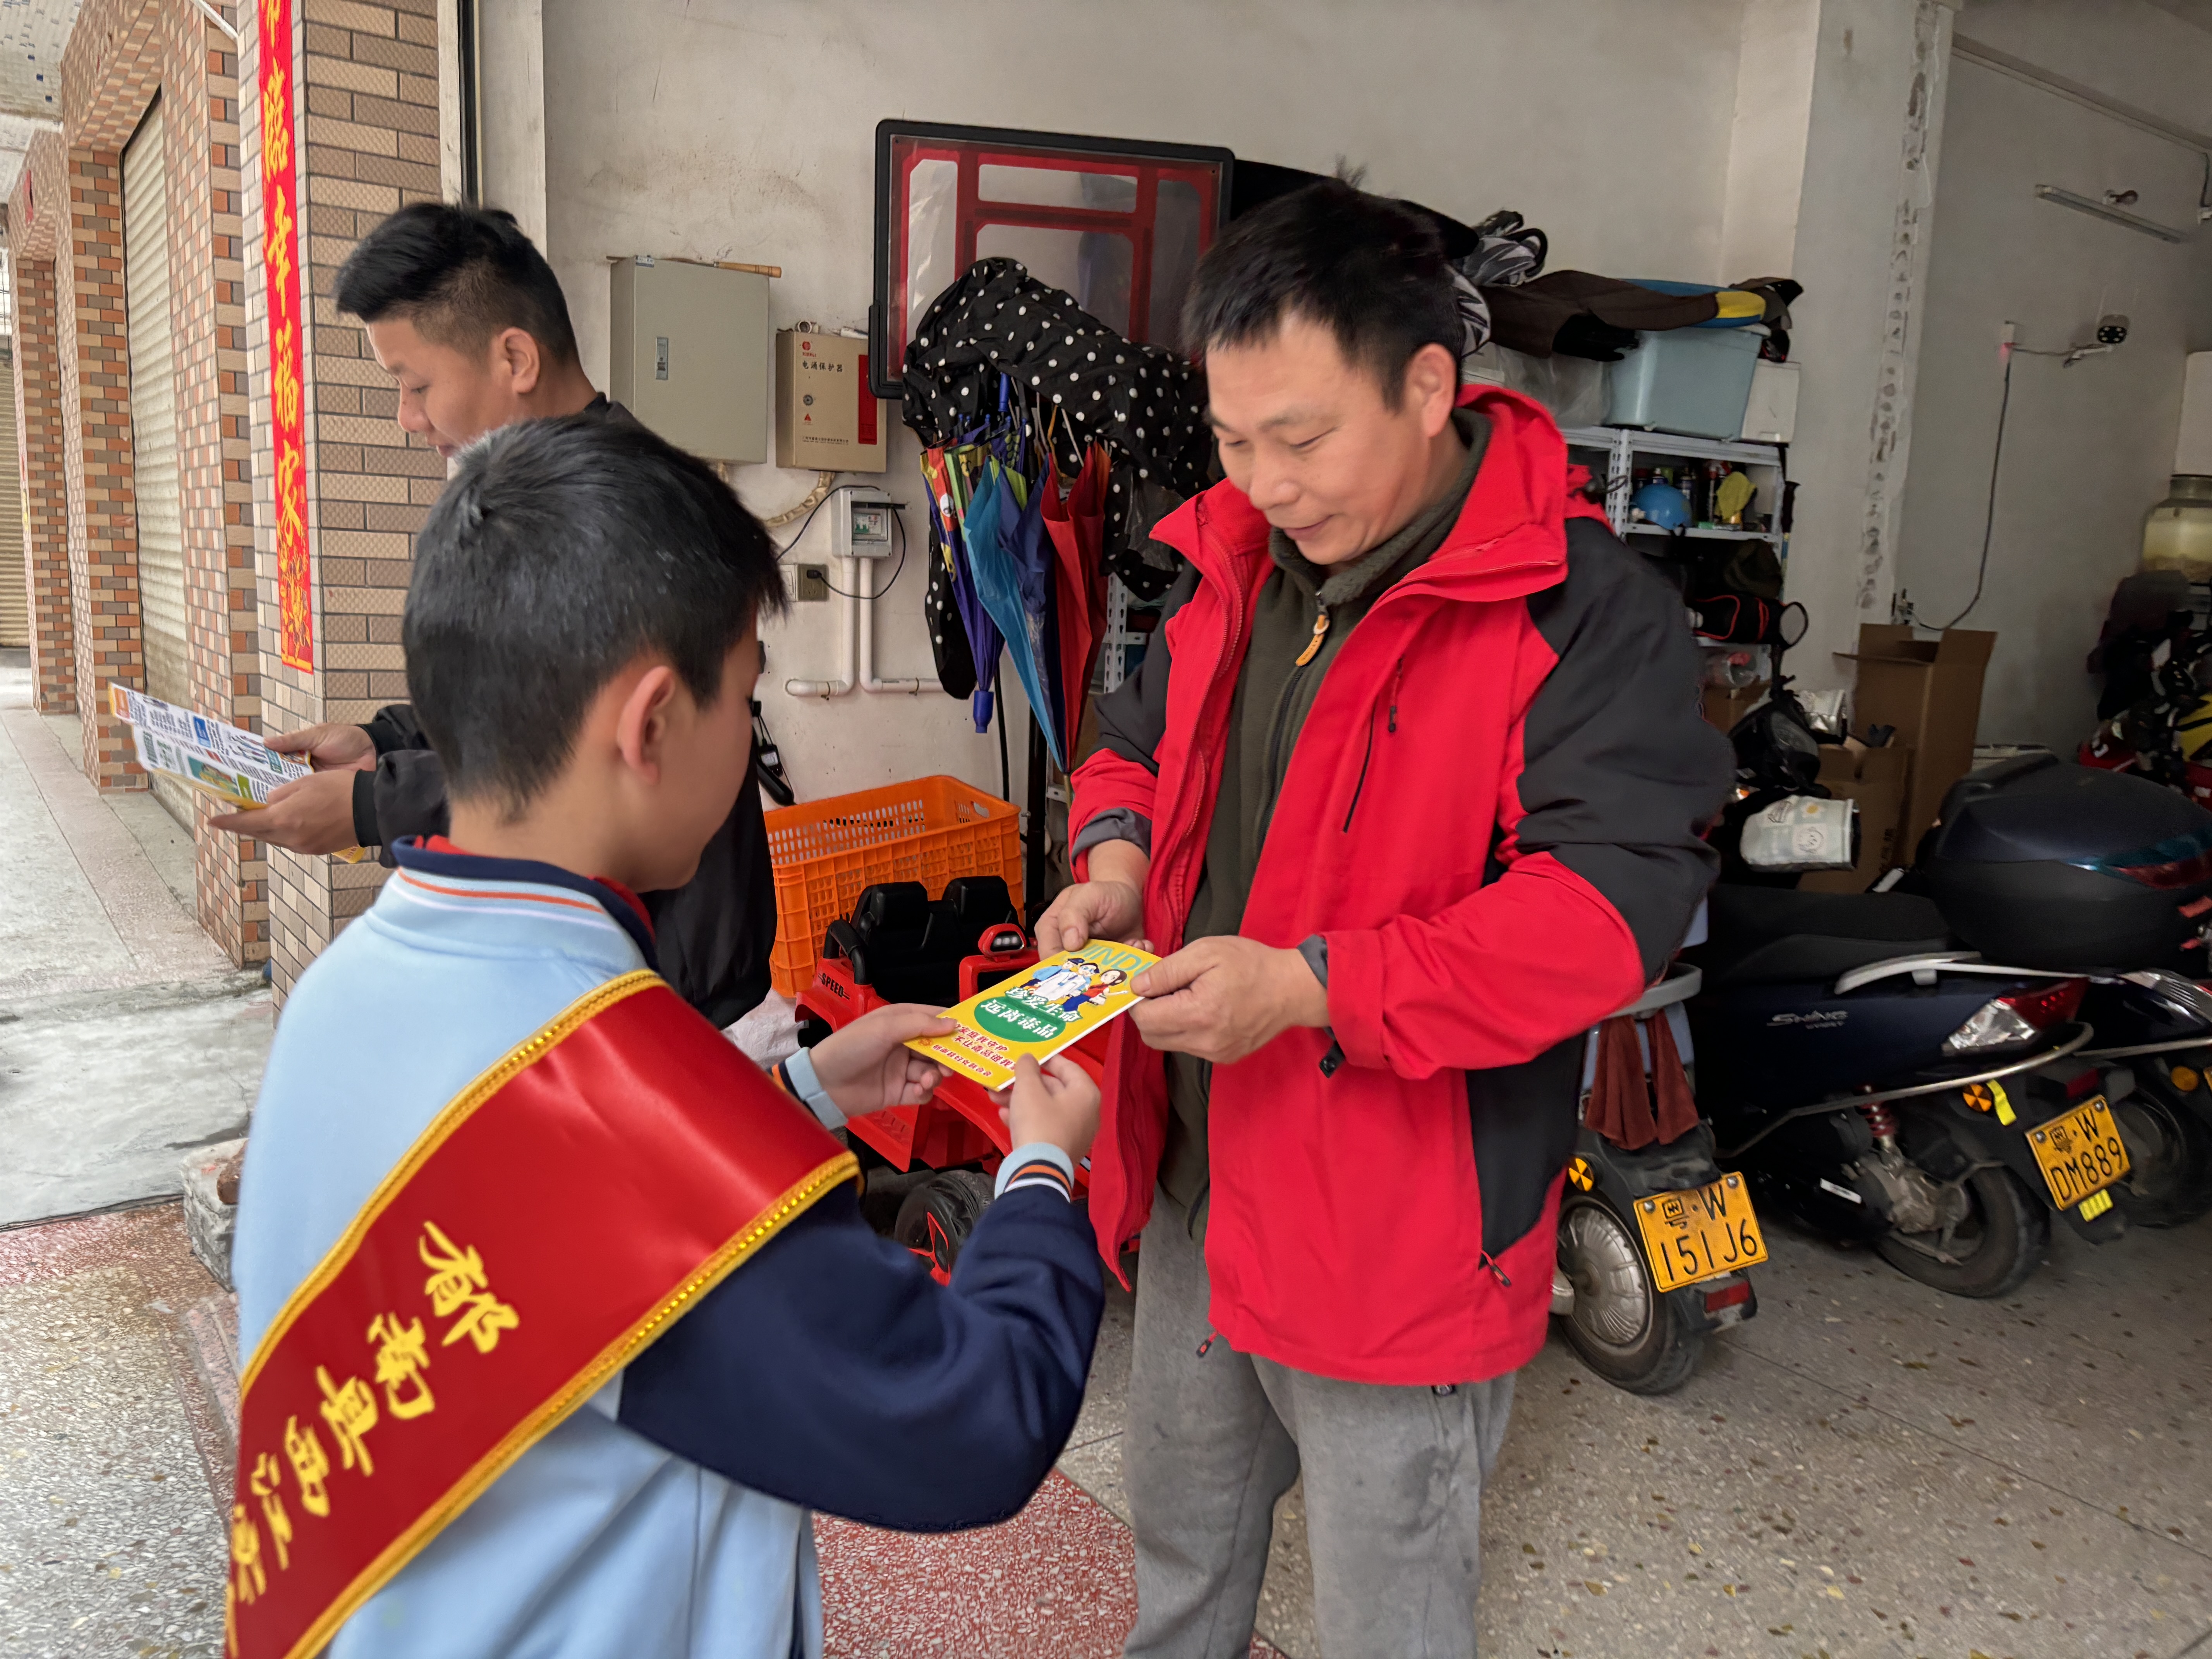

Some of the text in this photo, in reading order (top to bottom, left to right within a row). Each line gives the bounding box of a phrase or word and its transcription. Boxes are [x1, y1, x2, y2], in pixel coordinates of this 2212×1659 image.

[802, 360, 843, 373] 电涌保护器
[821, 972, 844, 998] SPEED
[981, 999, 1058, 1038] 远离毒品
[1006, 987, 1082, 1022] 珍爱生命
[955, 1036, 1015, 1070] 不让毒品进我
[2050, 1137, 2123, 1203] DM889
[1661, 1219, 1758, 1282] 151J6
